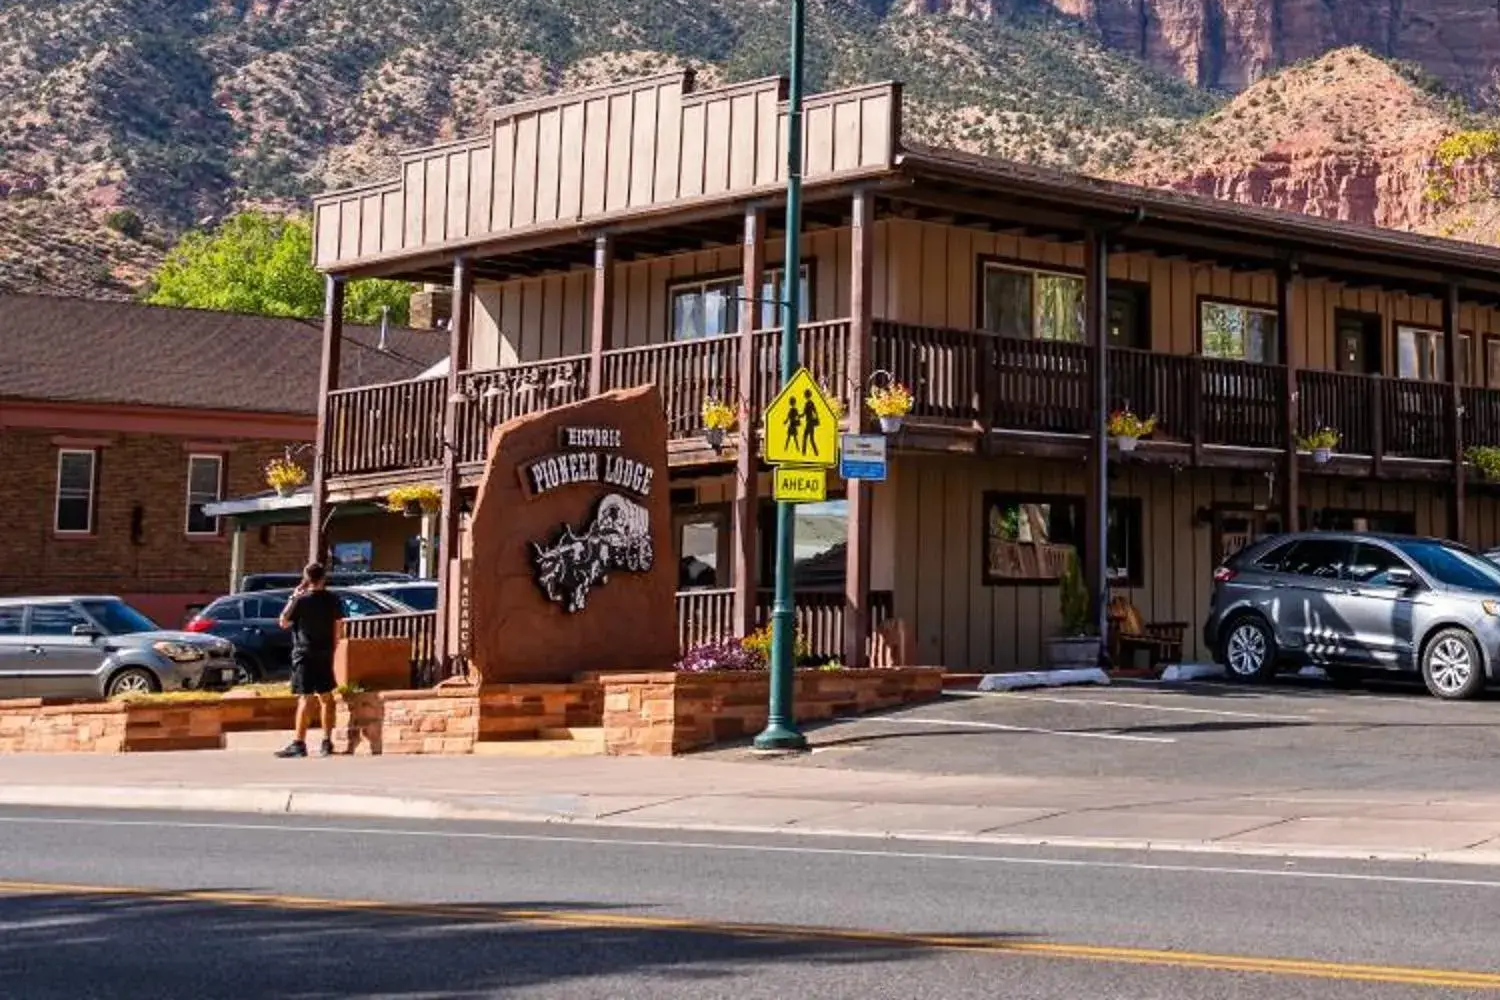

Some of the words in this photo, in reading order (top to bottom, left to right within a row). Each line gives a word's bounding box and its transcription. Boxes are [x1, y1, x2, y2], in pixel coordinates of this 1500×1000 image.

[566, 427, 621, 447] HISTORIC
[531, 452, 599, 493] PIONEER
[603, 453, 655, 495] LODGE
[781, 477, 819, 492] AHEAD
[460, 577, 471, 651] VACANCY
